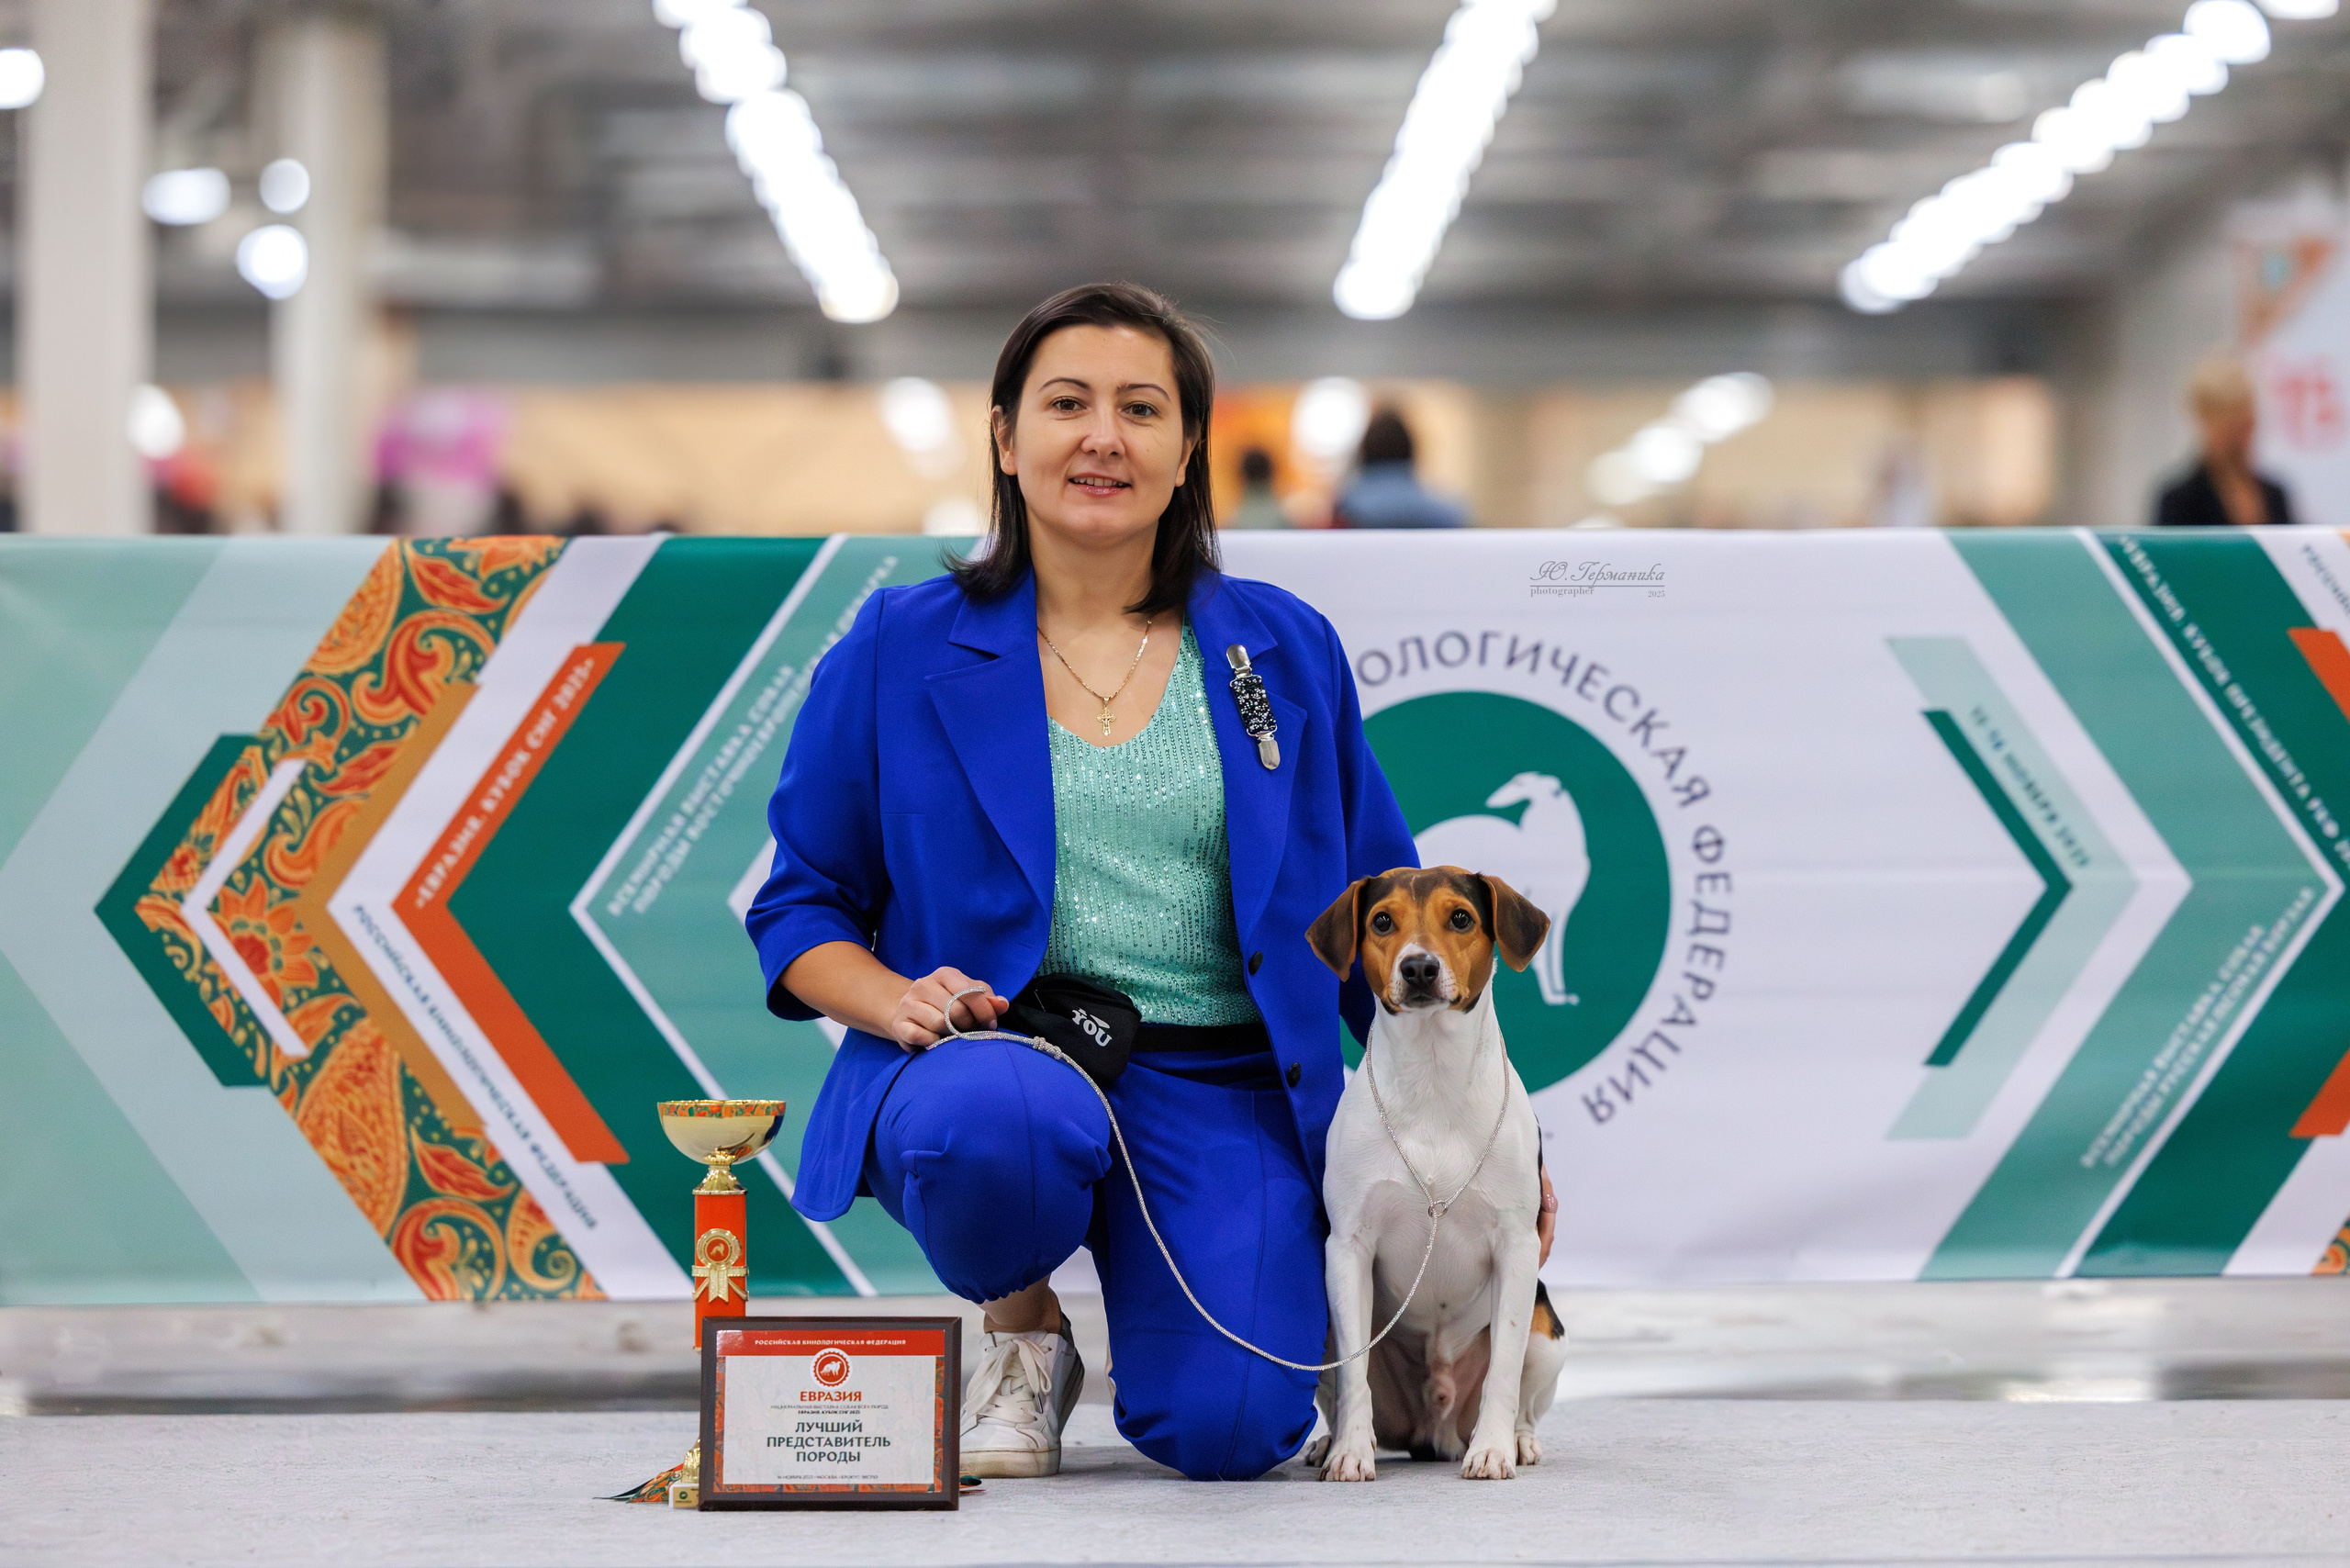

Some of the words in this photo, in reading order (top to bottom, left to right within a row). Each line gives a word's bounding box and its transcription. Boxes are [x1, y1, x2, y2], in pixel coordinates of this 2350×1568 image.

[1356, 631, 1711, 809] ОЛОГИЧЕСКАЯ
[1580, 823, 1733, 1125] ФЕДЕРАЦИЯ
[800, 1391, 862, 1402] ЕВРАЗИЯ
[795, 1419, 863, 1433] ЛУЧШИЙ
[767, 1437, 891, 1450] ПРЕДСТАВИТЕЛЬ
[796, 1451, 861, 1464] ПОРОДЫ
